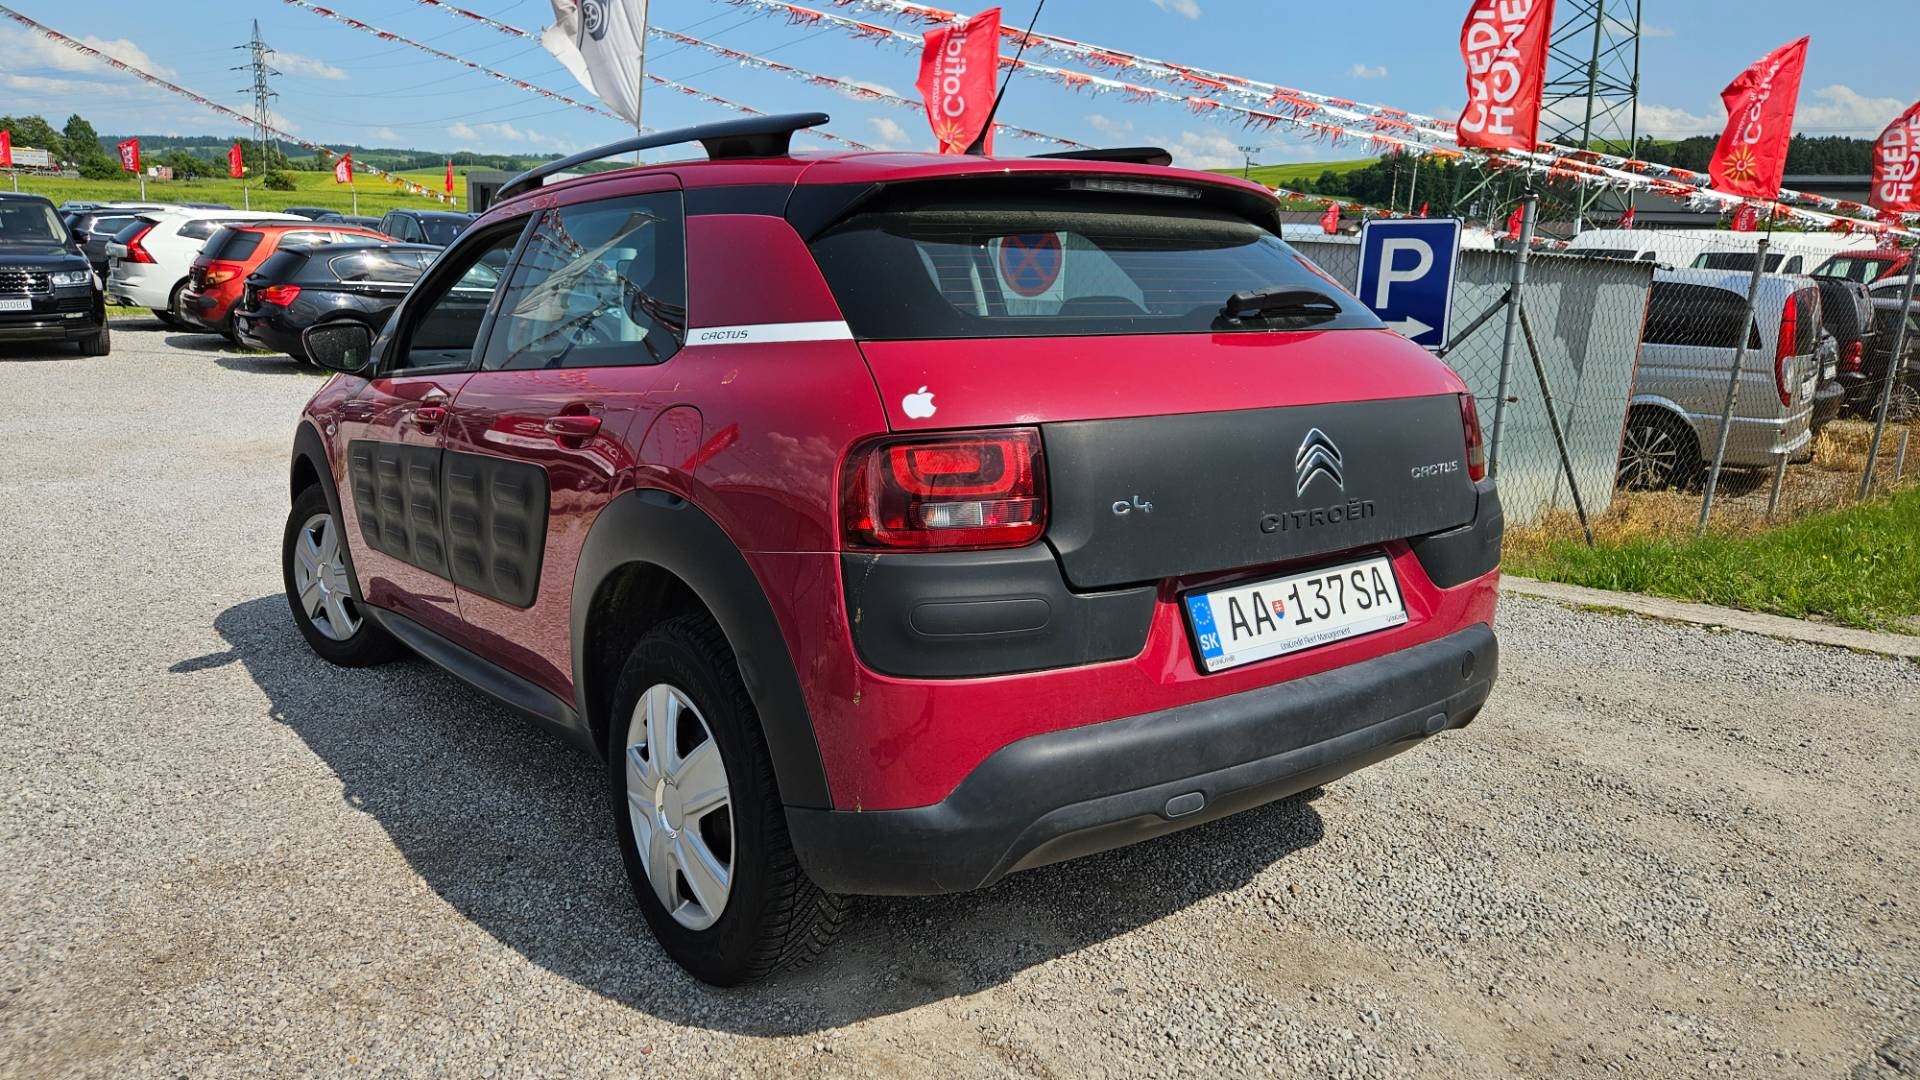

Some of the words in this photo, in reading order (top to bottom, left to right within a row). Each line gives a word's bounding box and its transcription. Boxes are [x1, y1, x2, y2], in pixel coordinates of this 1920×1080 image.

[1375, 238, 1434, 309] P
[701, 329, 748, 340] CACTUS
[1411, 460, 1458, 479] CACTUS
[1201, 633, 1220, 651] SK
